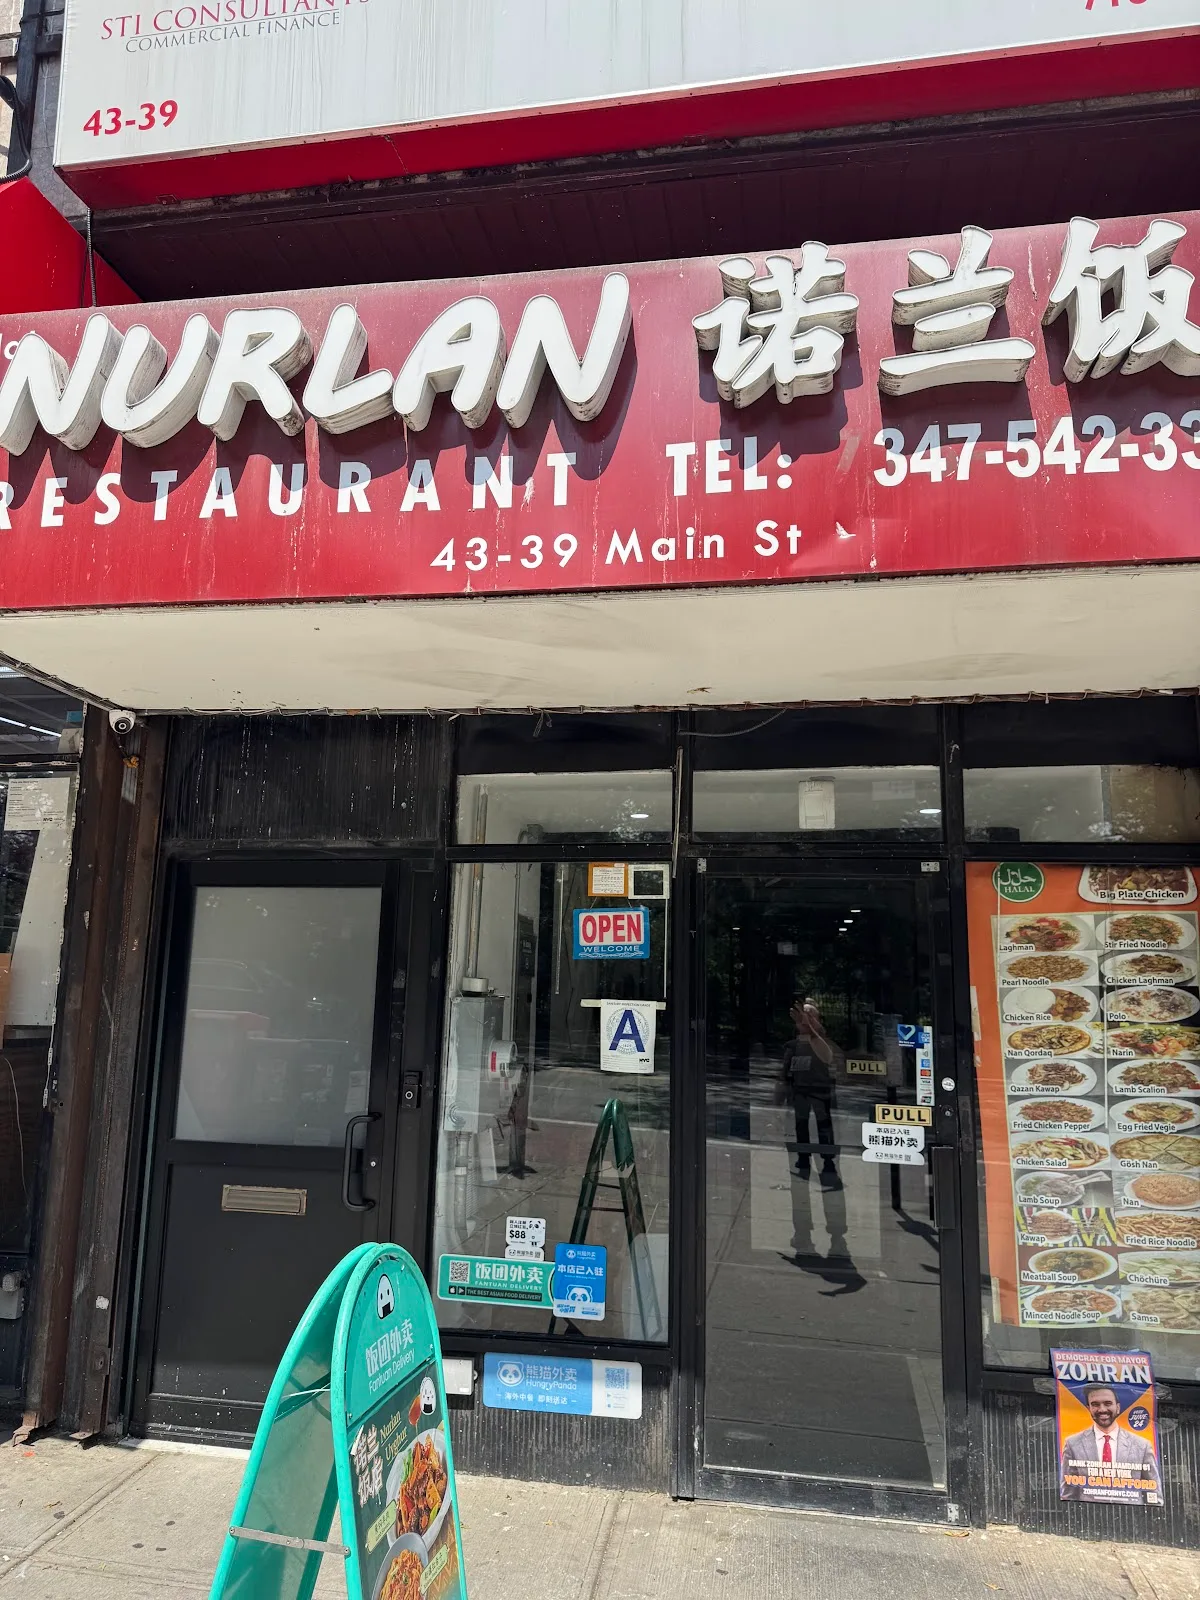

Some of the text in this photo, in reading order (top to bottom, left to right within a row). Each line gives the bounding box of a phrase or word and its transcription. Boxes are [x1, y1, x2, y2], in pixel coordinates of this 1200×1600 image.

[101, 0, 371, 40] STI CONSULTA
[125, 11, 340, 53] COMMERCIAL FINANCE
[83, 99, 178, 137] 43-39
[692, 216, 1200, 402] 诺兰饭
[0, 273, 632, 450] NURLAN
[665, 437, 793, 497] TEL:
[430, 518, 802, 573] 43-39 Main St
[1000, 868, 1037, 886] حلال
[1100, 889, 1184, 900] Big Plate Chicken
[581, 914, 642, 943] OPEN
[1000, 943, 1034, 952] Laghman
[1021, 978, 1050, 986] Noodle
[1138, 976, 1174, 985] Laghman
[1004, 1013, 1051, 1021] Chicken Rice
[608, 1010, 646, 1053] A
[1024, 1049, 1053, 1058] Qordaq
[1112, 1049, 1134, 1057] Narin
[850, 1062, 882, 1073] PULL
[1010, 1085, 1060, 1094] Qazan Kawap
[1138, 1086, 1166, 1094] Scalion
[881, 1108, 927, 1122] PULL
[1013, 1121, 1090, 1132] Fried Chicken Pepper
[1117, 1123, 1176, 1133] Egg Fried Vegie
[868, 1135, 918, 1148] 熊猫外卖
[1016, 1158, 1067, 1167] Chicken Salad
[1120, 1160, 1140, 1168] Gösh
[1040, 1197, 1060, 1206] Soup
[1123, 1198, 1140, 1206] Nan
[509, 1229, 526, 1239] $88
[1020, 1235, 1046, 1243] Kawap
[1126, 1236, 1196, 1247] Fried Rice Noodle
[475, 1262, 544, 1284] 饭团外卖
[557, 1264, 604, 1277] 本店已入驻
[1022, 1273, 1077, 1282] Meatball Soup
[510, 1283, 543, 1291] DELIVERY
[1025, 1311, 1100, 1320] Minced Noodle Soup
[1131, 1313, 1159, 1323] Samsa
[366, 1318, 413, 1377] 饭团外卖
[1056, 1353, 1099, 1362] DEMOCRAT
[1118, 1357, 1147, 1365] MAYOR
[369, 1348, 415, 1396] Fantuan Delivery
[526, 1364, 577, 1382] 熊猫外卖
[1055, 1361, 1153, 1384] ZOHRAN
[526, 1379, 577, 1391] HungryPanda
[1064, 1475, 1157, 1490] YOU CAN AFFORD
